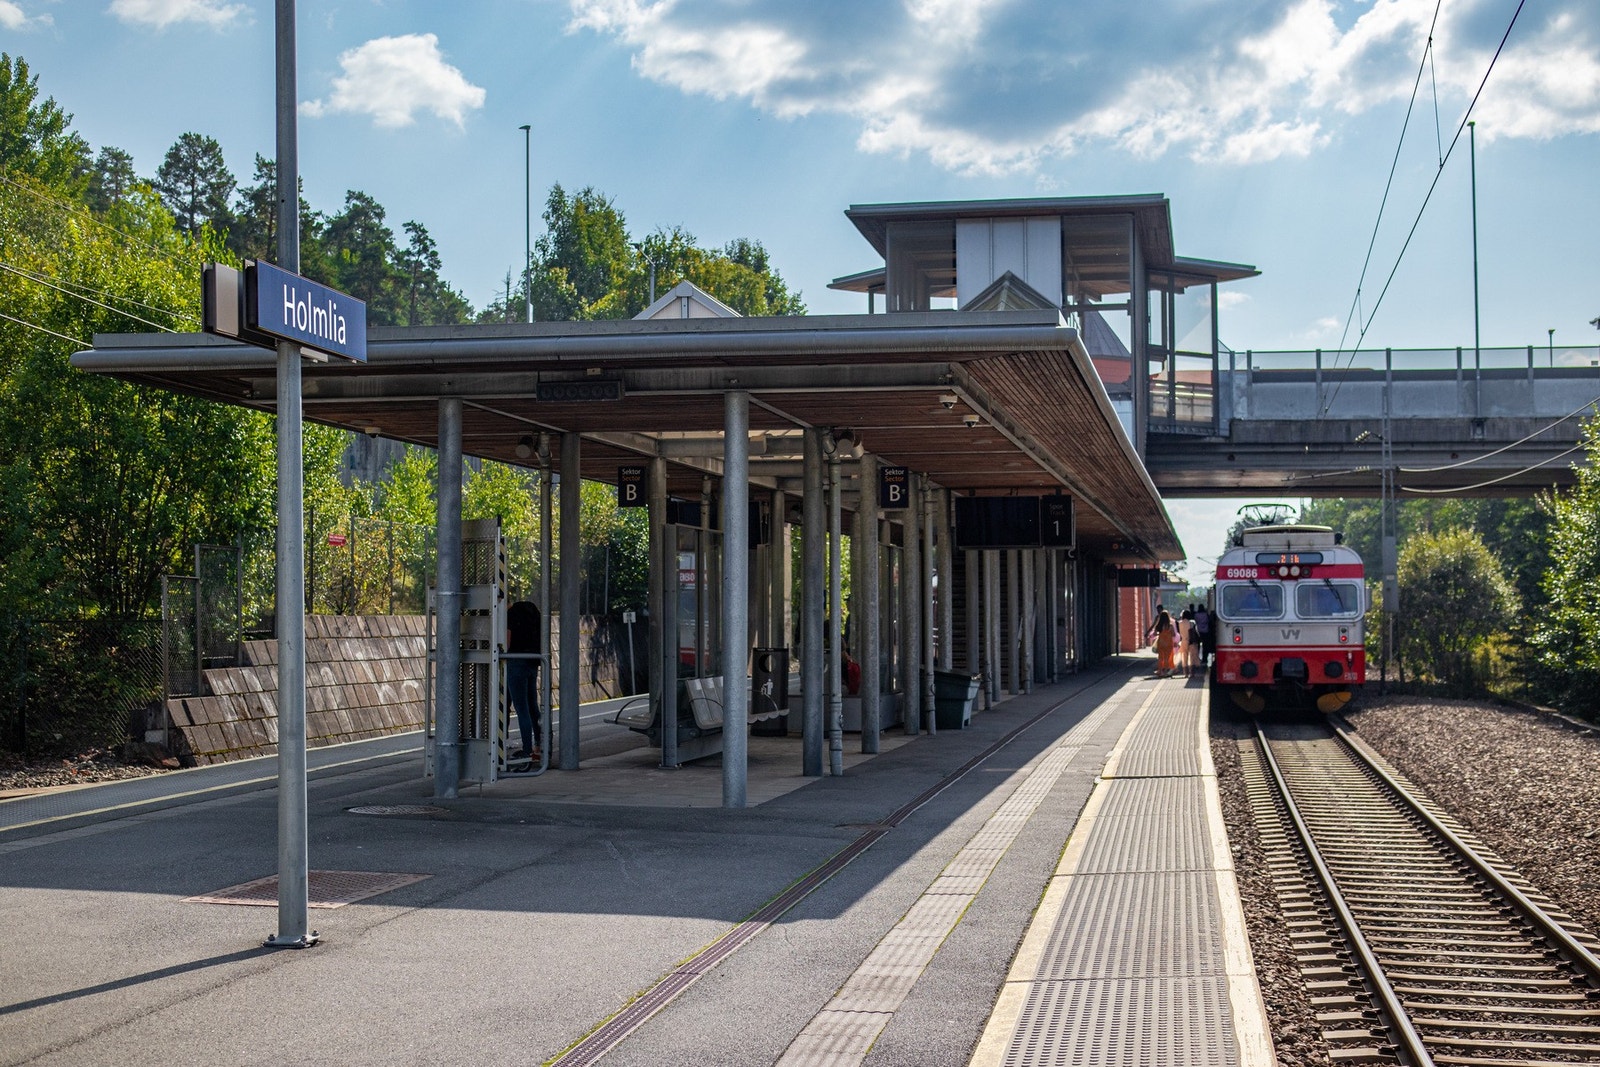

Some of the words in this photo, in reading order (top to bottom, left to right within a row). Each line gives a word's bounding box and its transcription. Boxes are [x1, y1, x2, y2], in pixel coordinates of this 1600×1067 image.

[283, 283, 346, 345] Holmlia
[626, 484, 637, 501] B
[889, 484, 900, 502] B
[1053, 520, 1059, 536] 1
[1227, 568, 1258, 578] 69086
